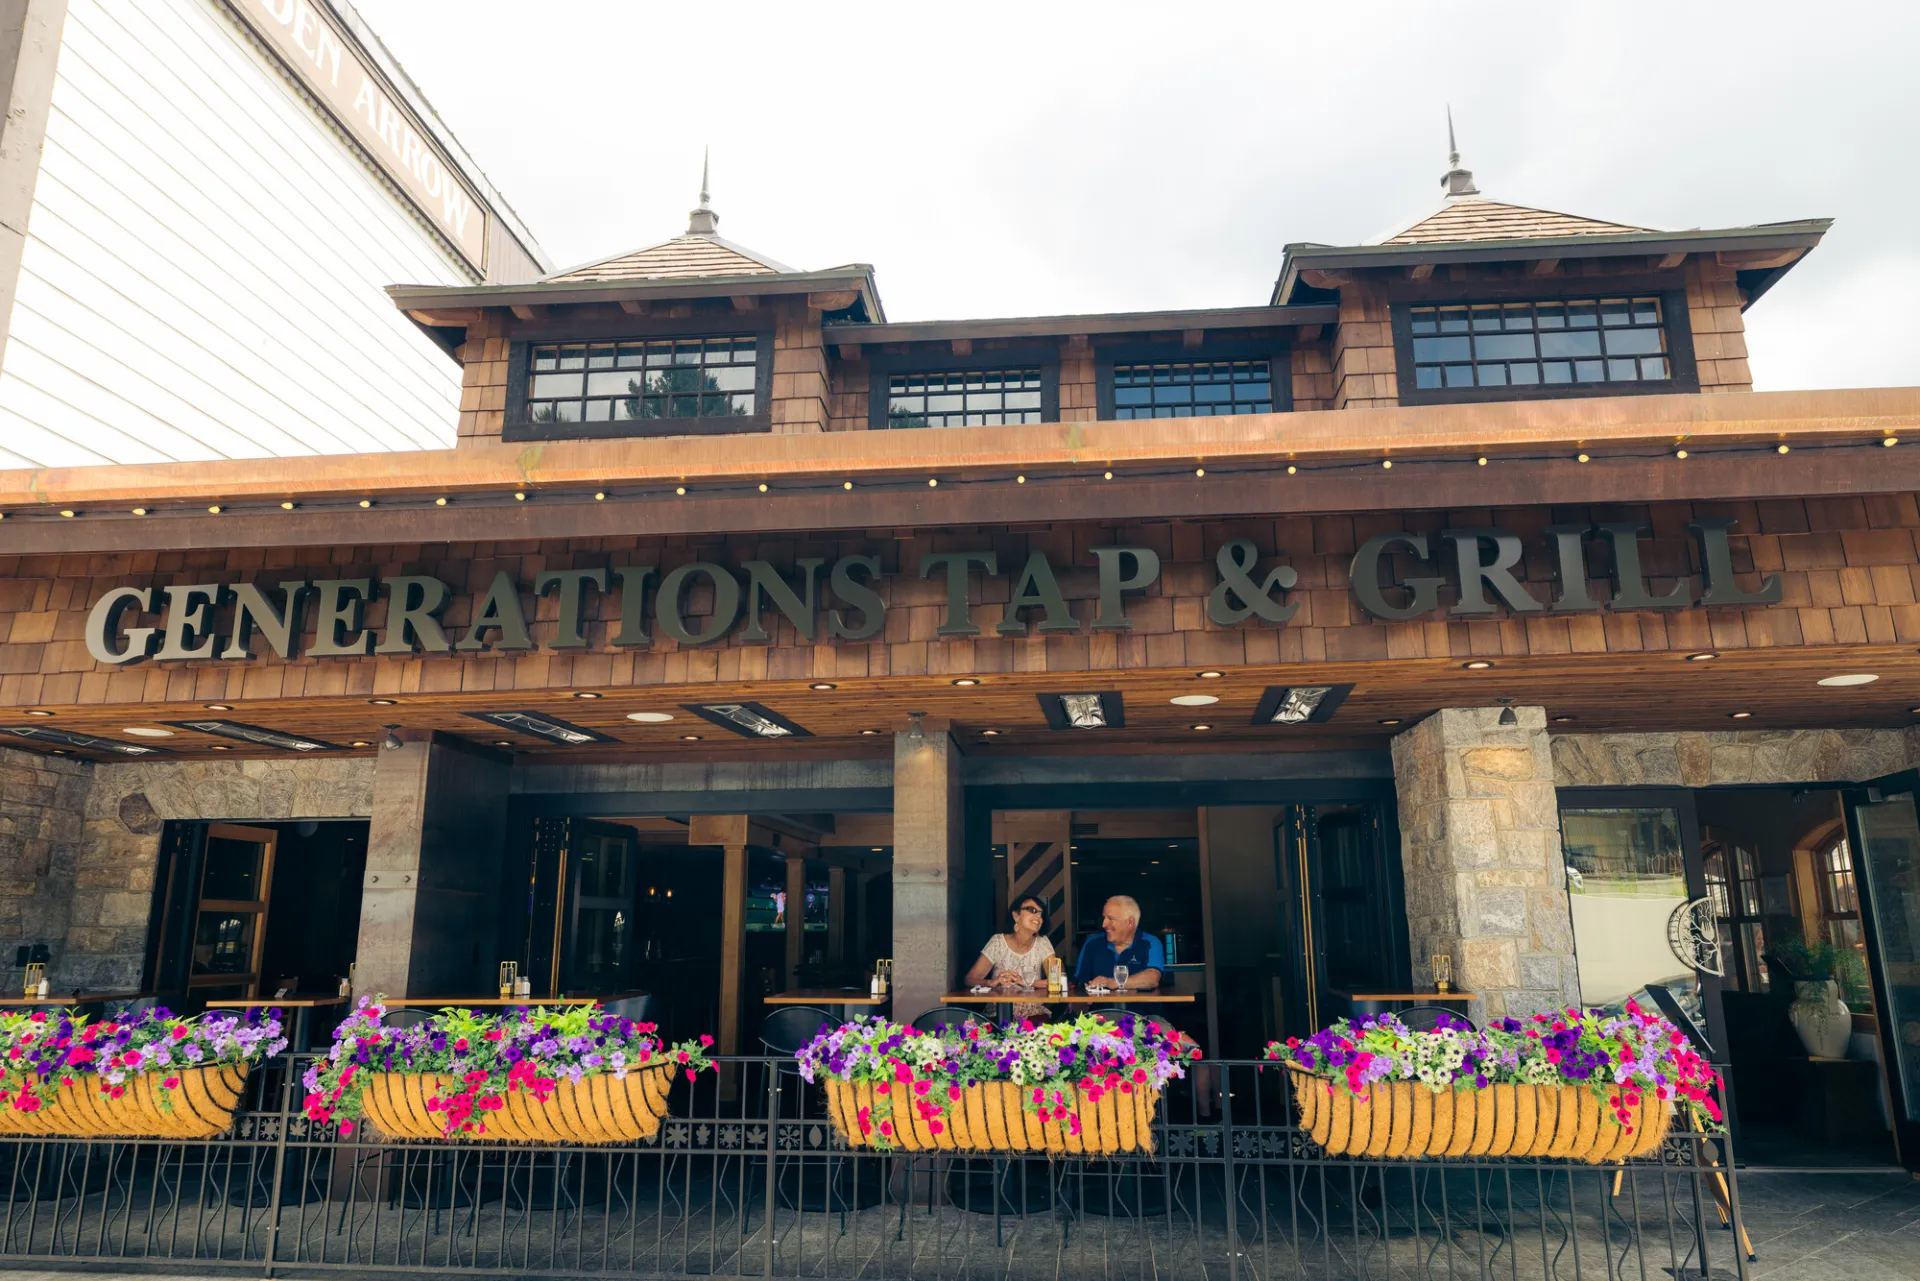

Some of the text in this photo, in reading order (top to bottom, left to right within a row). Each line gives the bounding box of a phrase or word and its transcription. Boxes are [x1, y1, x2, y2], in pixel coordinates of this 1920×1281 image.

[353, 75, 470, 240] ARROW
[85, 518, 1784, 664] GENERATIONS TAP & GRILL
